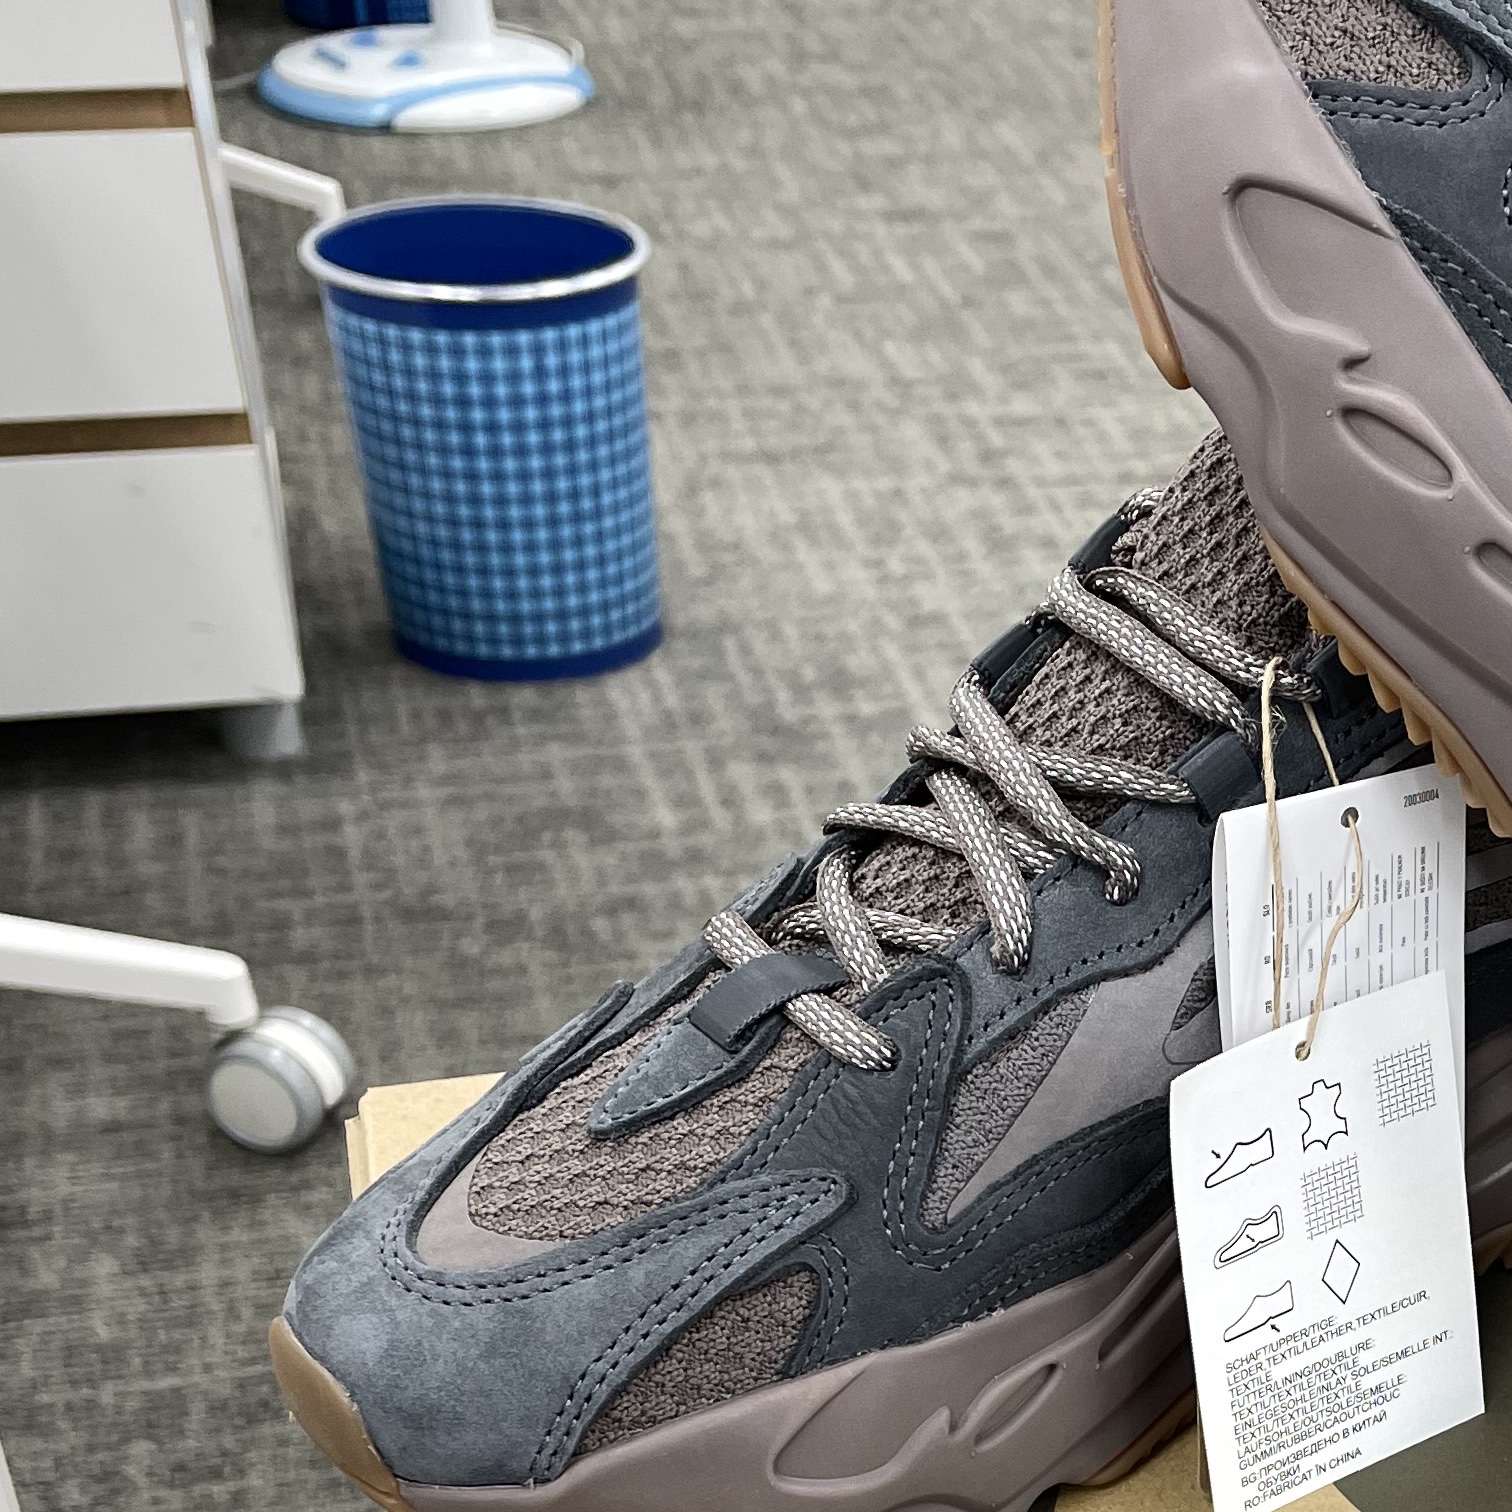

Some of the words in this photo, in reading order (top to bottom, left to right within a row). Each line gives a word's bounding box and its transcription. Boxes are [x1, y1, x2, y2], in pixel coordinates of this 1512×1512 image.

[1228, 1370, 1273, 1399] TEXTILE
[1232, 1356, 1360, 1423] TEXTIL/TEXTILE/TEXTILE
[1233, 1374, 1348, 1436] EINLEGESOHLE/INLAY
[1350, 1338, 1431, 1381] SOLE/SEMELLE
[1235, 1379, 1363, 1448] TEXTIL/TEXTILE/TEXTILE
[1238, 1387, 1401, 1471] GUMMI/RUBBER/CAOUTCHOUC
[1328, 1446, 1363, 1470] CHINA
